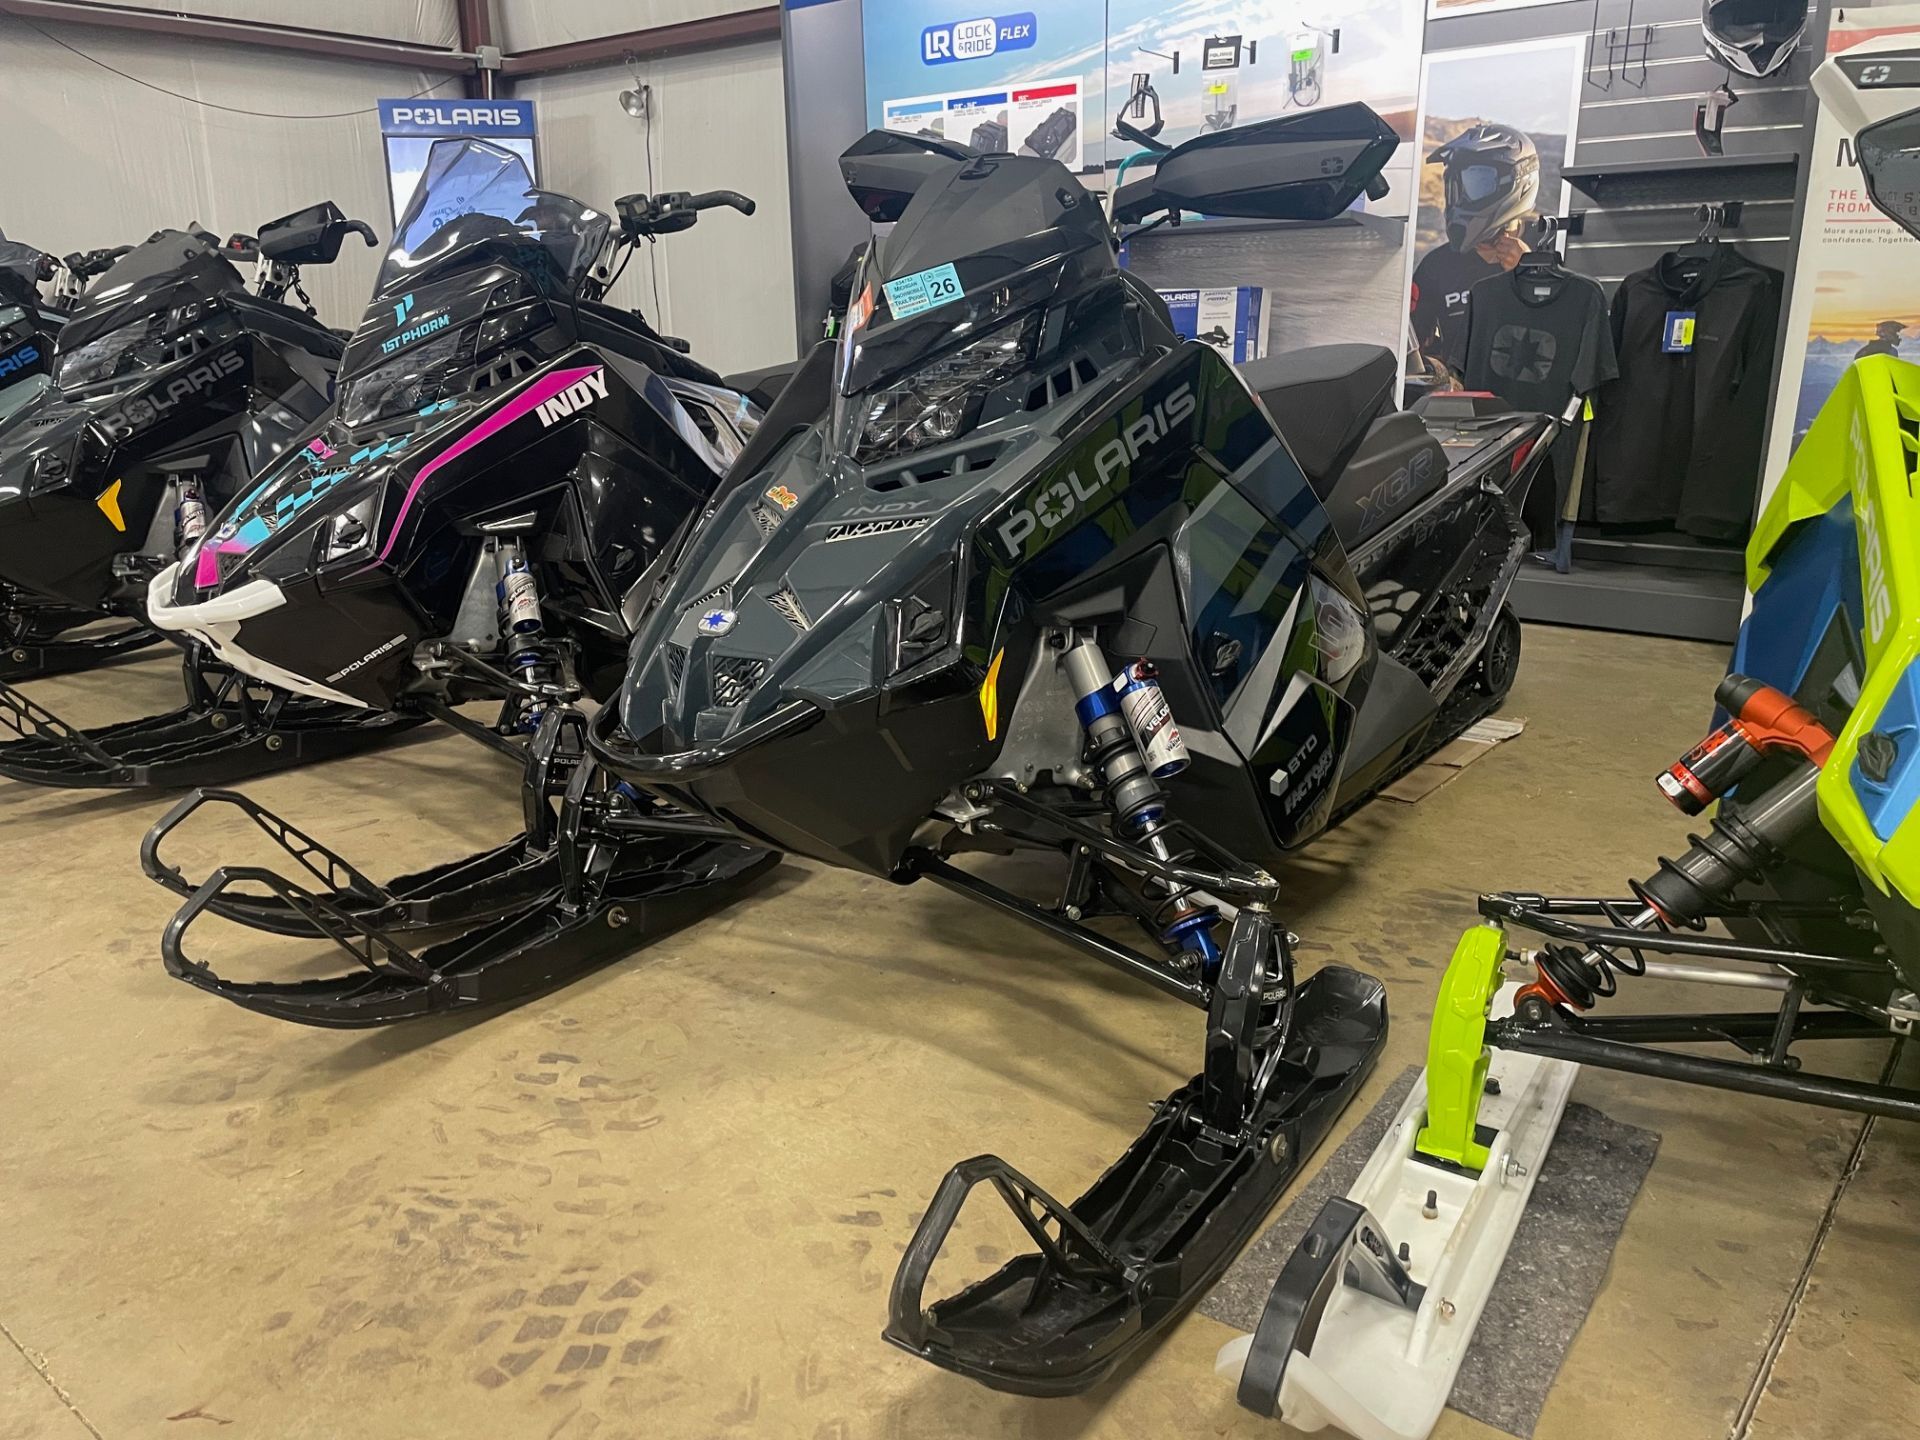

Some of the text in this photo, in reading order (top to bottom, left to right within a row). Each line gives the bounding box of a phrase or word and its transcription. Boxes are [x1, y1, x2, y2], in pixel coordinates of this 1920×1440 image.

[958, 23, 992, 40] LOCK
[1000, 24, 1031, 41] FLEX
[392, 107, 521, 126] POLARIS
[1829, 189, 1858, 200] THE
[1827, 202, 1871, 213] FROM
[1822, 236, 1875, 244] confidence.
[892, 286, 924, 300] SNOWMOBILE
[894, 281, 918, 292] MICHIGAN
[930, 277, 956, 299] 26
[1160, 292, 1198, 301] OLARIS
[381, 314, 450, 354] 1ST PHORM
[101, 350, 245, 436] POLARIS
[535, 367, 610, 428] INDY
[997, 382, 1196, 558] POLARIS
[841, 500, 930, 518] INDY
[1850, 405, 1892, 644] POLARIS
[340, 642, 393, 676] POLARIS
[1287, 733, 1318, 775] BTO
